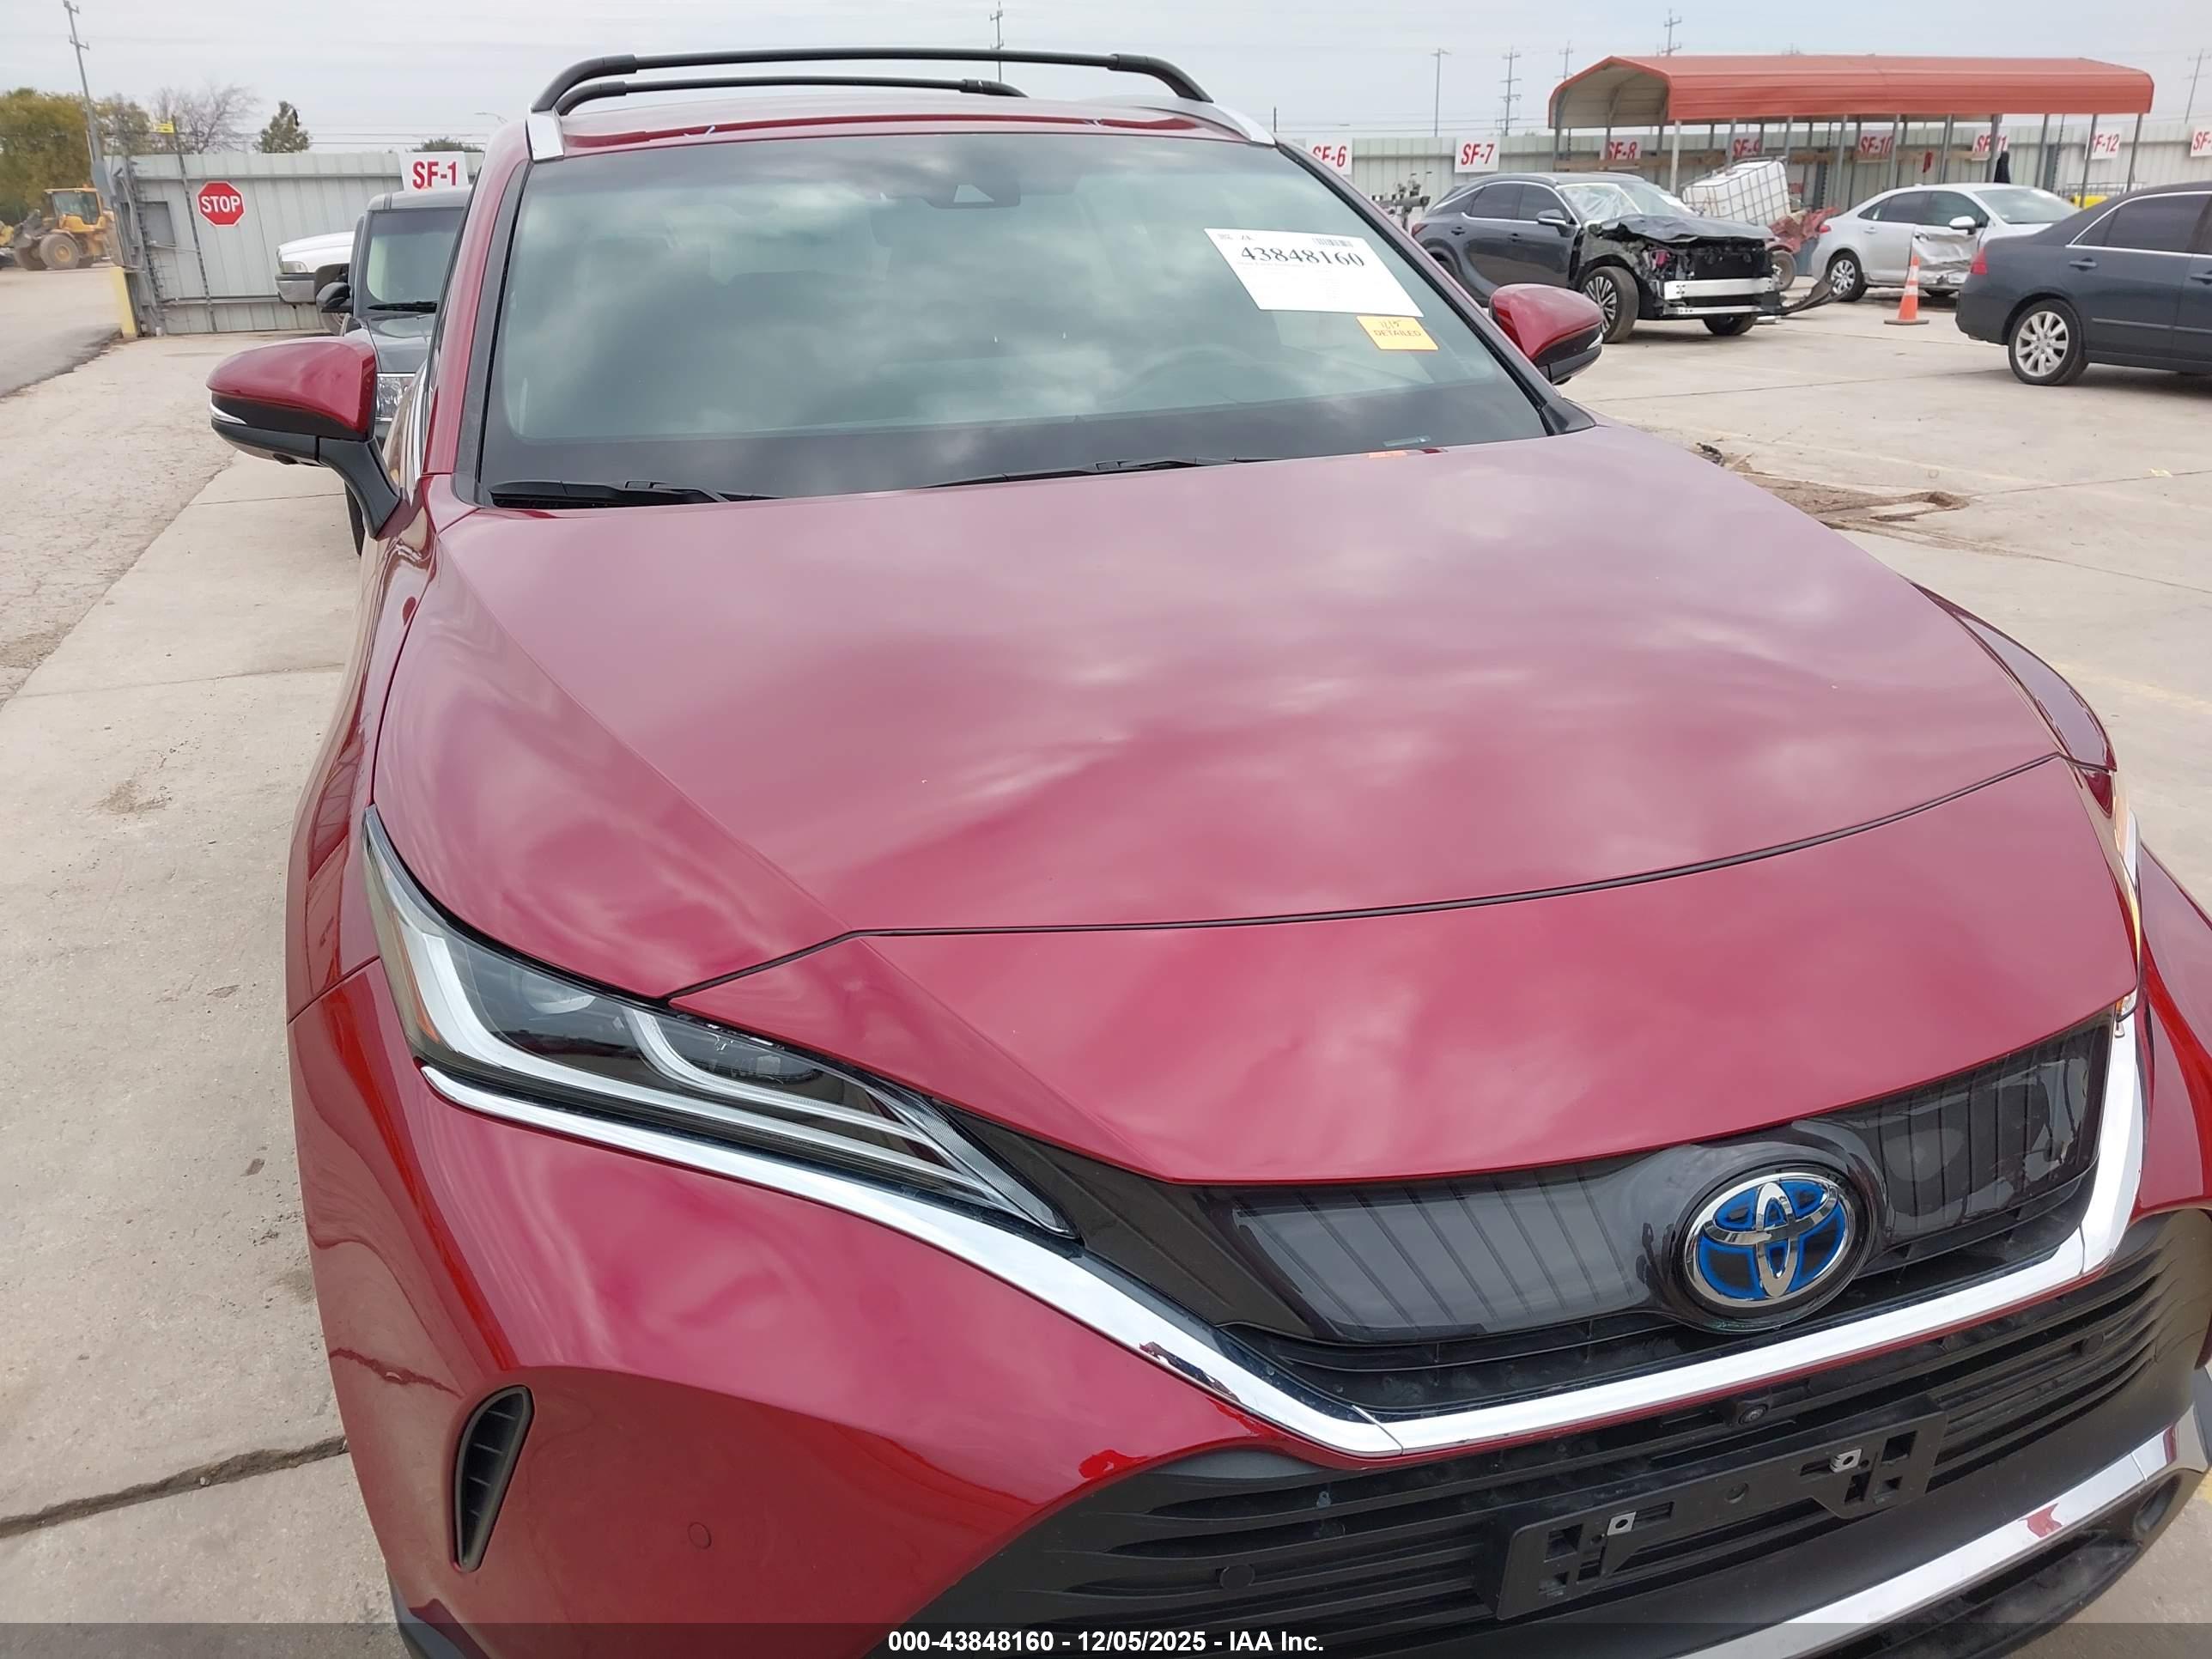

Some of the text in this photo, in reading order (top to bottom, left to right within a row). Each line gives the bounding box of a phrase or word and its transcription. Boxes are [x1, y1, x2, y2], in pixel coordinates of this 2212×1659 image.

[2093, 133, 2120, 152] F-12
[2193, 131, 2212, 150] SF-
[1313, 145, 1347, 167] SF-6
[1461, 143, 1495, 165] SF-7
[412, 161, 457, 189] SF-1
[201, 195, 241, 213] STOP
[1241, 246, 1365, 267] 43848160
